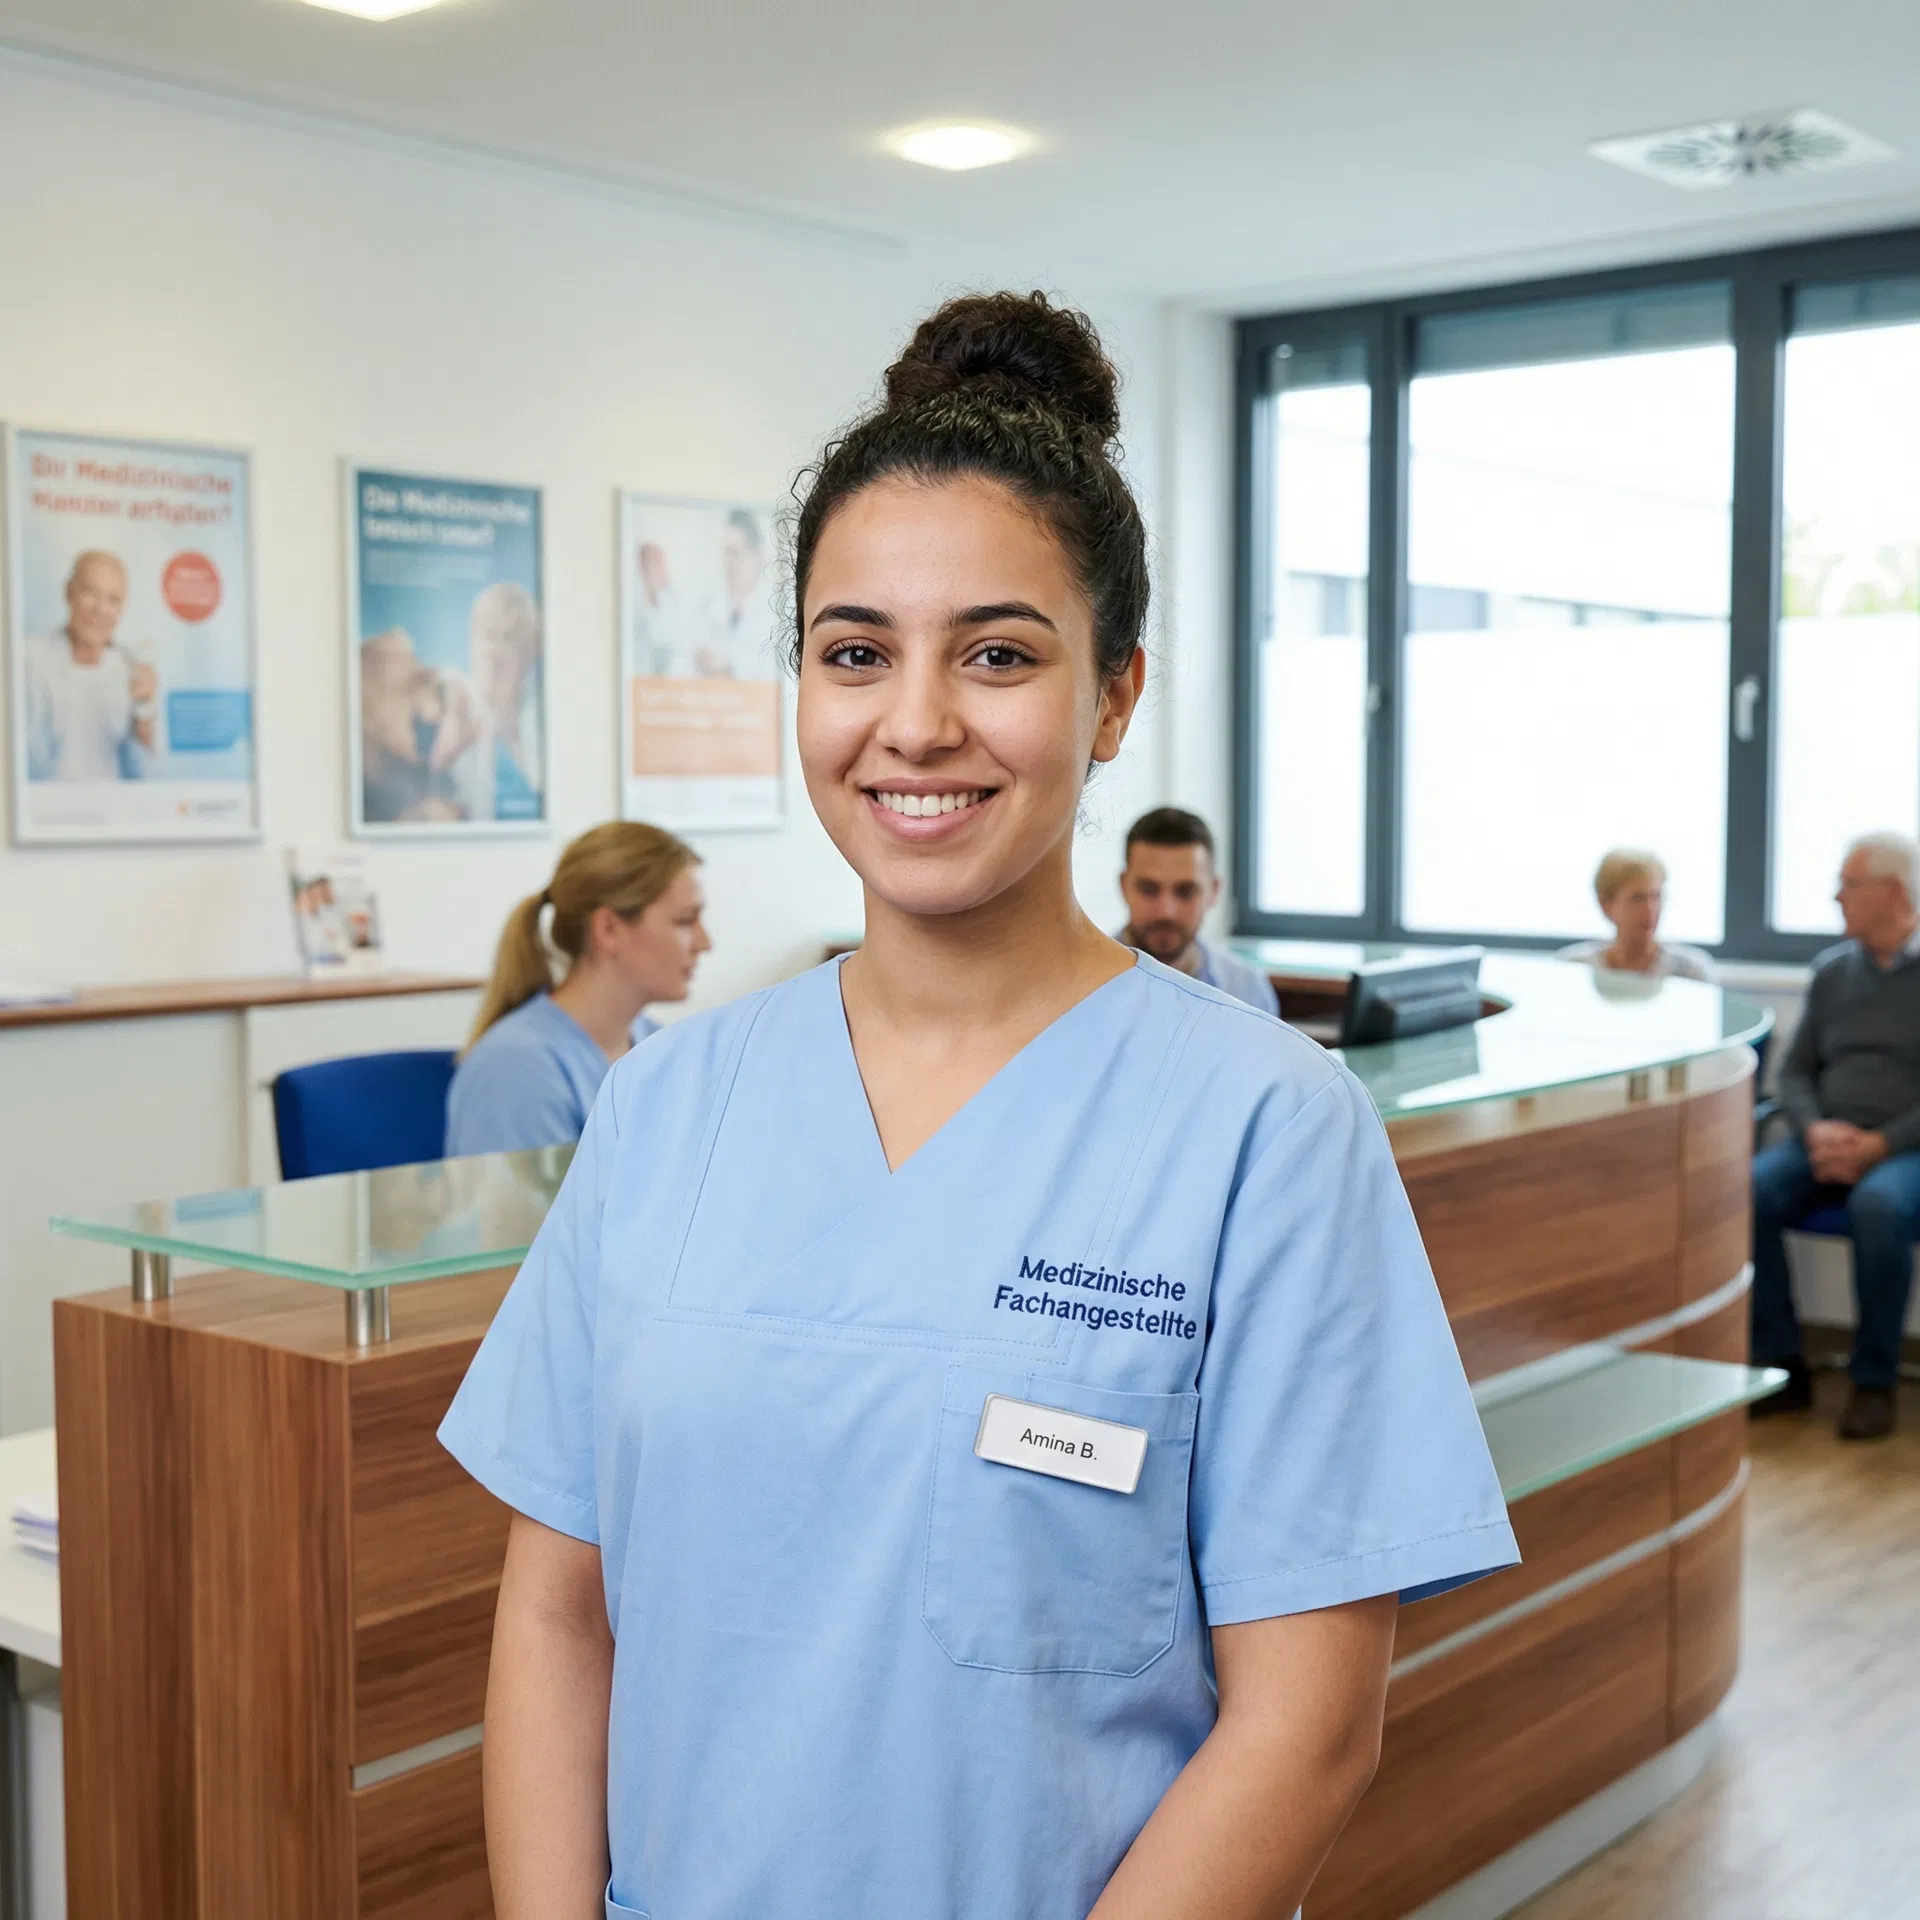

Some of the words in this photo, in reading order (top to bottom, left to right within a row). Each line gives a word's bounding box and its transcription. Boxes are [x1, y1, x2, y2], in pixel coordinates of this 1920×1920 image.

[1019, 1256, 1186, 1301] Medizinische
[994, 1284, 1197, 1340] Fachangestellte
[1020, 1428, 1075, 1455] Amina
[1080, 1442, 1097, 1460] B.
